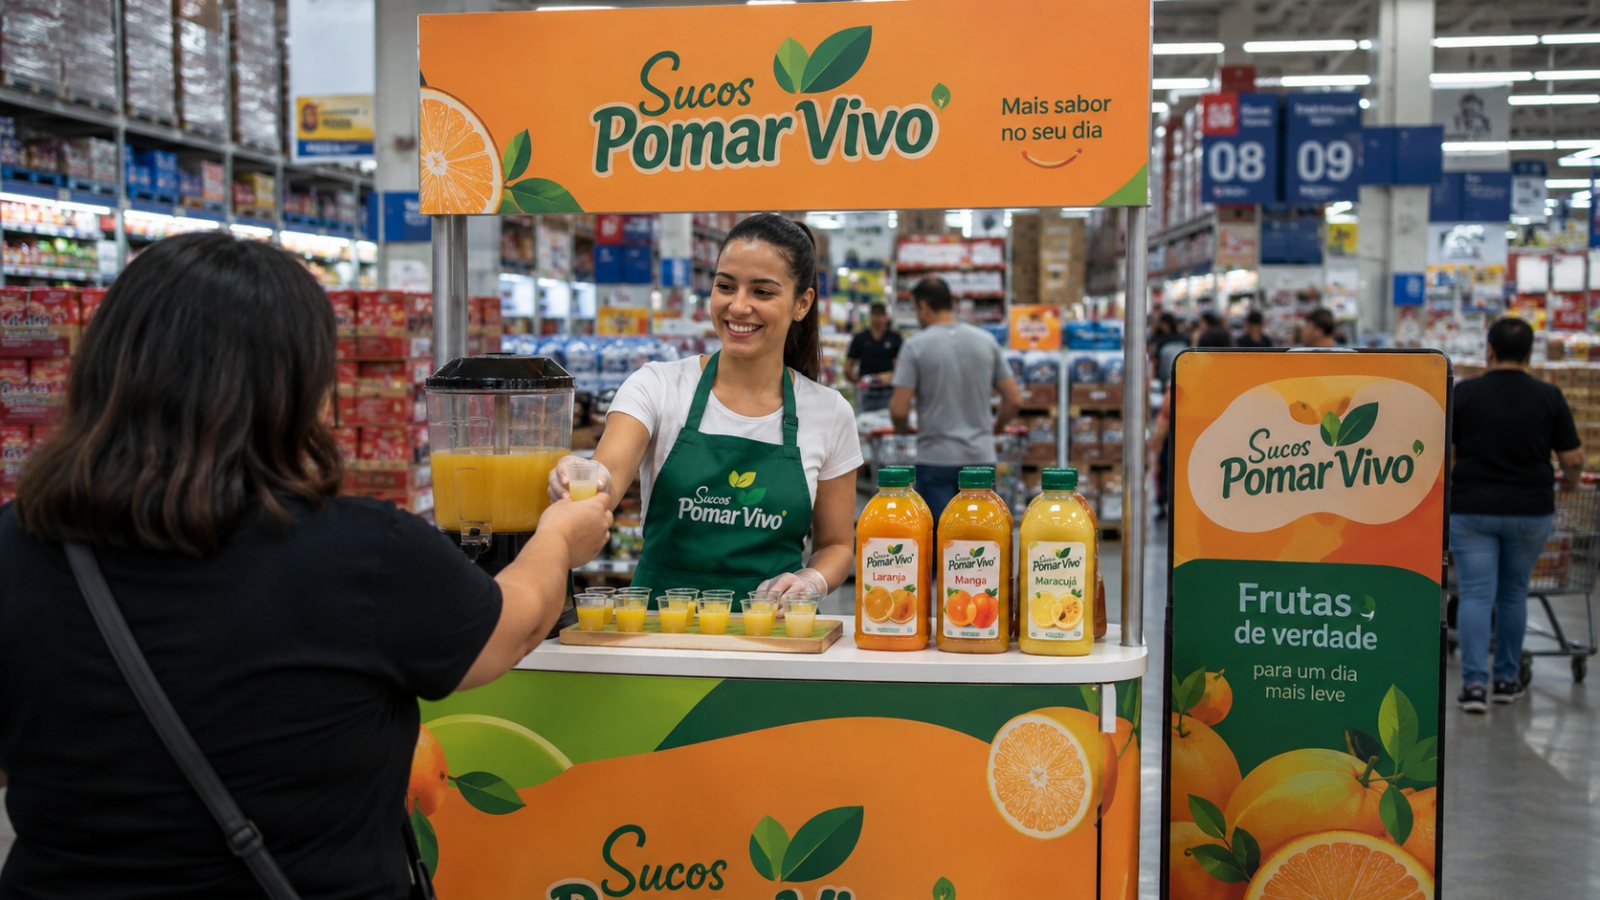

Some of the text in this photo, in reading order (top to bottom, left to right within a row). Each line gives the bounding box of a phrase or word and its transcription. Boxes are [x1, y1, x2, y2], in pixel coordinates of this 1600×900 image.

[638, 50, 755, 117] Sucos
[1001, 94, 1112, 115] Mais sabor
[592, 97, 935, 174] Pomar Vivo
[1001, 120, 1102, 141] no seu dia
[1208, 141, 1266, 183] 08
[1296, 140, 1354, 182] 09
[1248, 428, 1311, 464] Sucos
[1220, 448, 1414, 499] Pomar Vivo
[678, 497, 783, 530] Pomar Vivo
[867, 557, 894, 569] Pomar
[894, 554, 913, 565] Vivo
[948, 560, 976, 571] Pomar
[976, 557, 994, 568] Vivo
[1033, 560, 1061, 572] Pomar
[1062, 558, 1080, 569] Vivo
[872, 572, 906, 584] Laranja
[955, 575, 987, 587] Manga
[1035, 576, 1077, 588] Maracujá
[1238, 582, 1352, 617] Frutas
[1234, 620, 1378, 650] de verdade
[1253, 664, 1358, 682] para um dia
[1265, 684, 1346, 702] mais leve
[601, 824, 727, 898] Sucos
